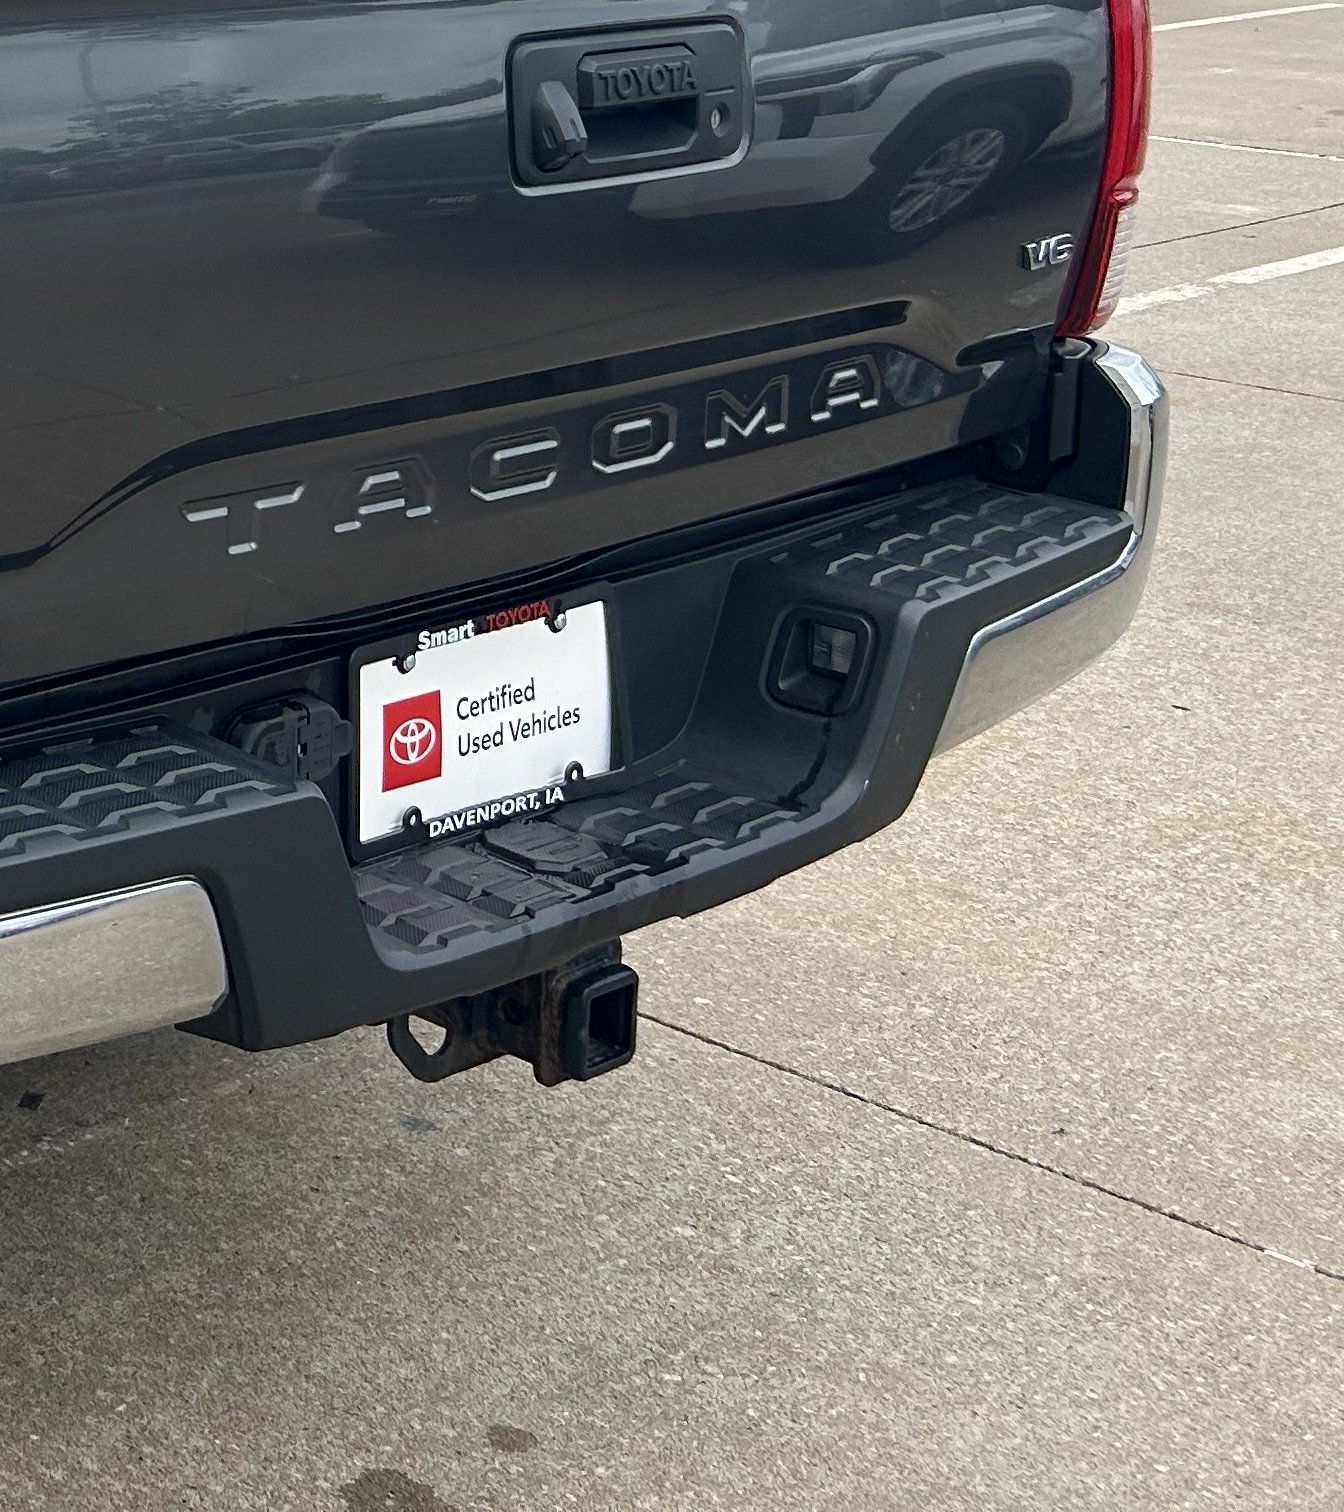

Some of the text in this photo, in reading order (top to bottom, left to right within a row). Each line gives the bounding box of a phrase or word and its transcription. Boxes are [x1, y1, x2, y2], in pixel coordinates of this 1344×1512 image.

[598, 60, 699, 101] TOYOTA
[1024, 233, 1074, 271] V6
[179, 354, 882, 555] TACOMA
[418, 600, 552, 649] Smart TOYOTA
[456, 677, 536, 720] Certified
[458, 705, 581, 757] Used Vehicles
[429, 786, 565, 838] DAVENPORT, IA
